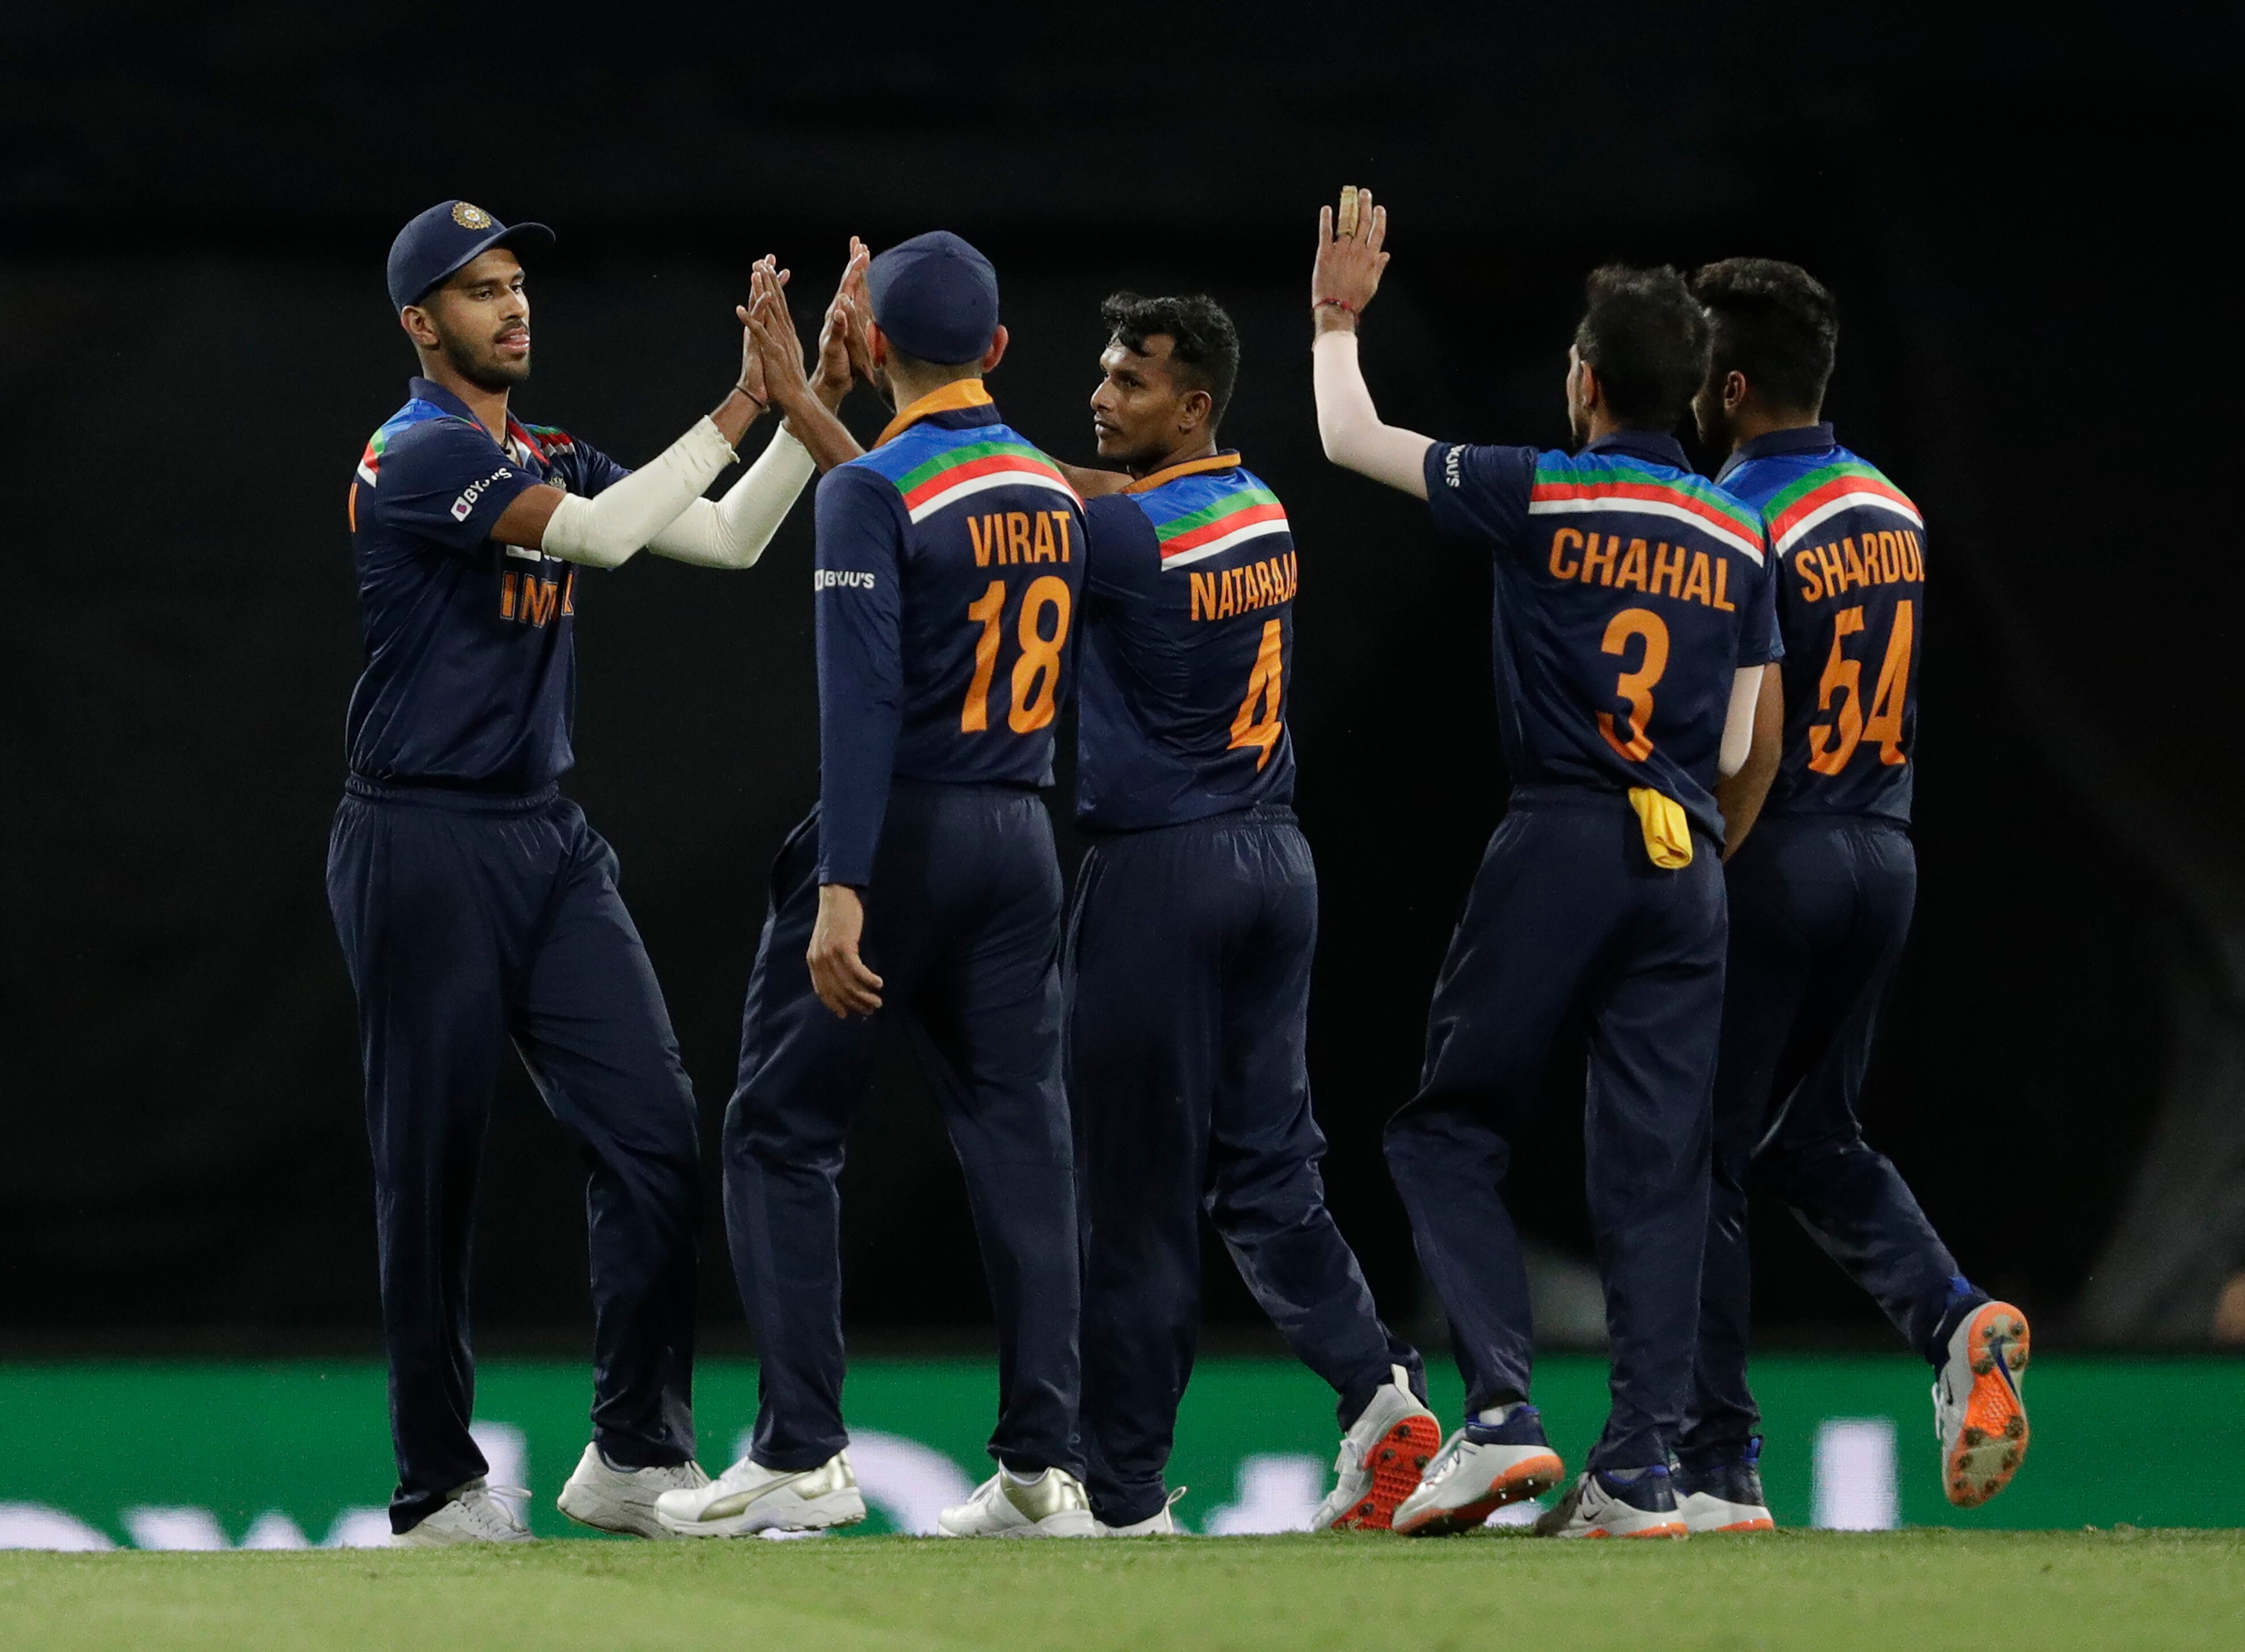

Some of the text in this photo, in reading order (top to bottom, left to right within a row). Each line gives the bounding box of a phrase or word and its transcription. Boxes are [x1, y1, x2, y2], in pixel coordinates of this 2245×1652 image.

[825, 571, 875, 590] BYJU'S
[967, 510, 1071, 567] VIRAT
[1549, 527, 1735, 612] CHAHAL
[961, 575, 1071, 734] 18
[1226, 618, 1283, 773] 4
[1596, 607, 1670, 762] 3
[1807, 599, 1914, 776] 54
